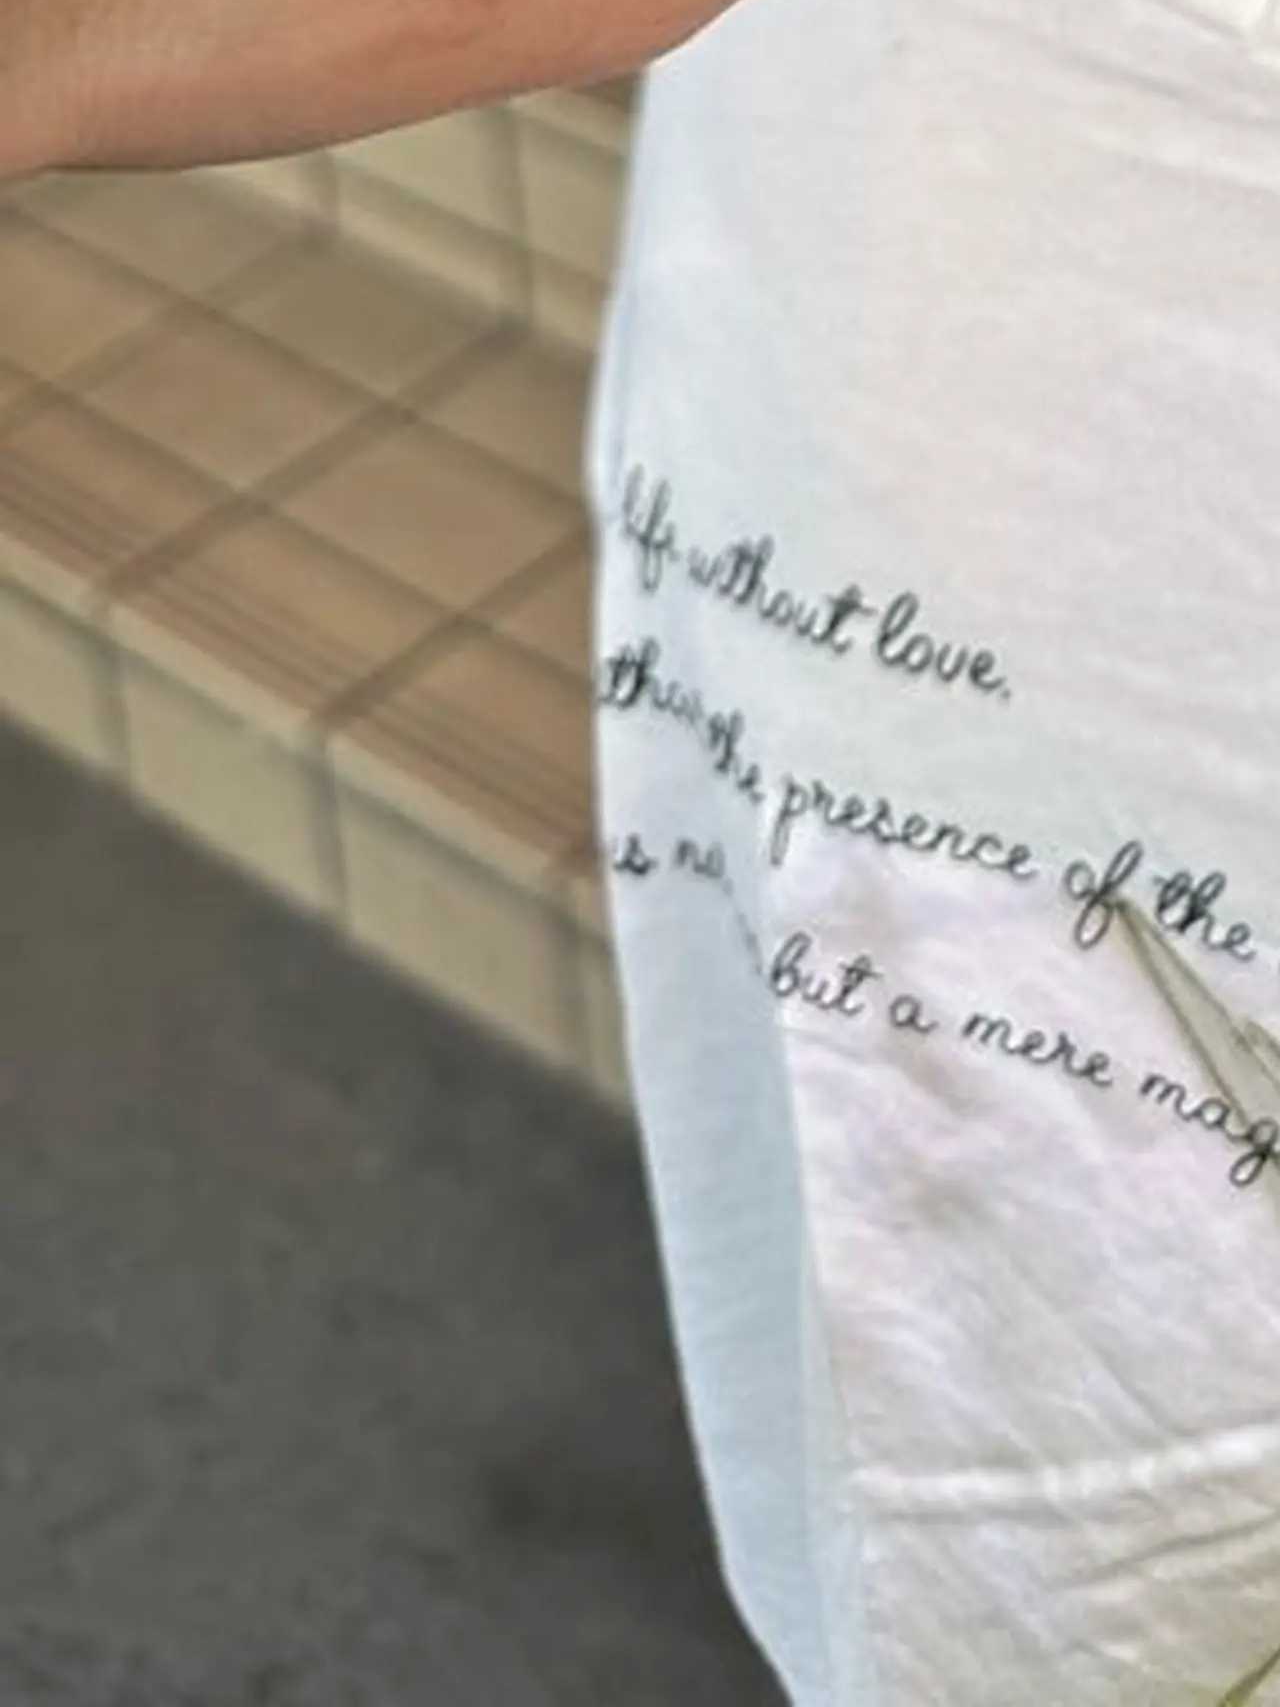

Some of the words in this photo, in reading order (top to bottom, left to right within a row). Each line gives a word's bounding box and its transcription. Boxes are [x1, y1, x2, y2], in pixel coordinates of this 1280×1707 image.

[770, 774, 1038, 881] presence
[1063, 839, 1143, 950] of
[1152, 871, 1255, 963] the
[769, 930, 884, 1018] but
[888, 993, 939, 1035] a
[963, 1011, 1113, 1089] mere
